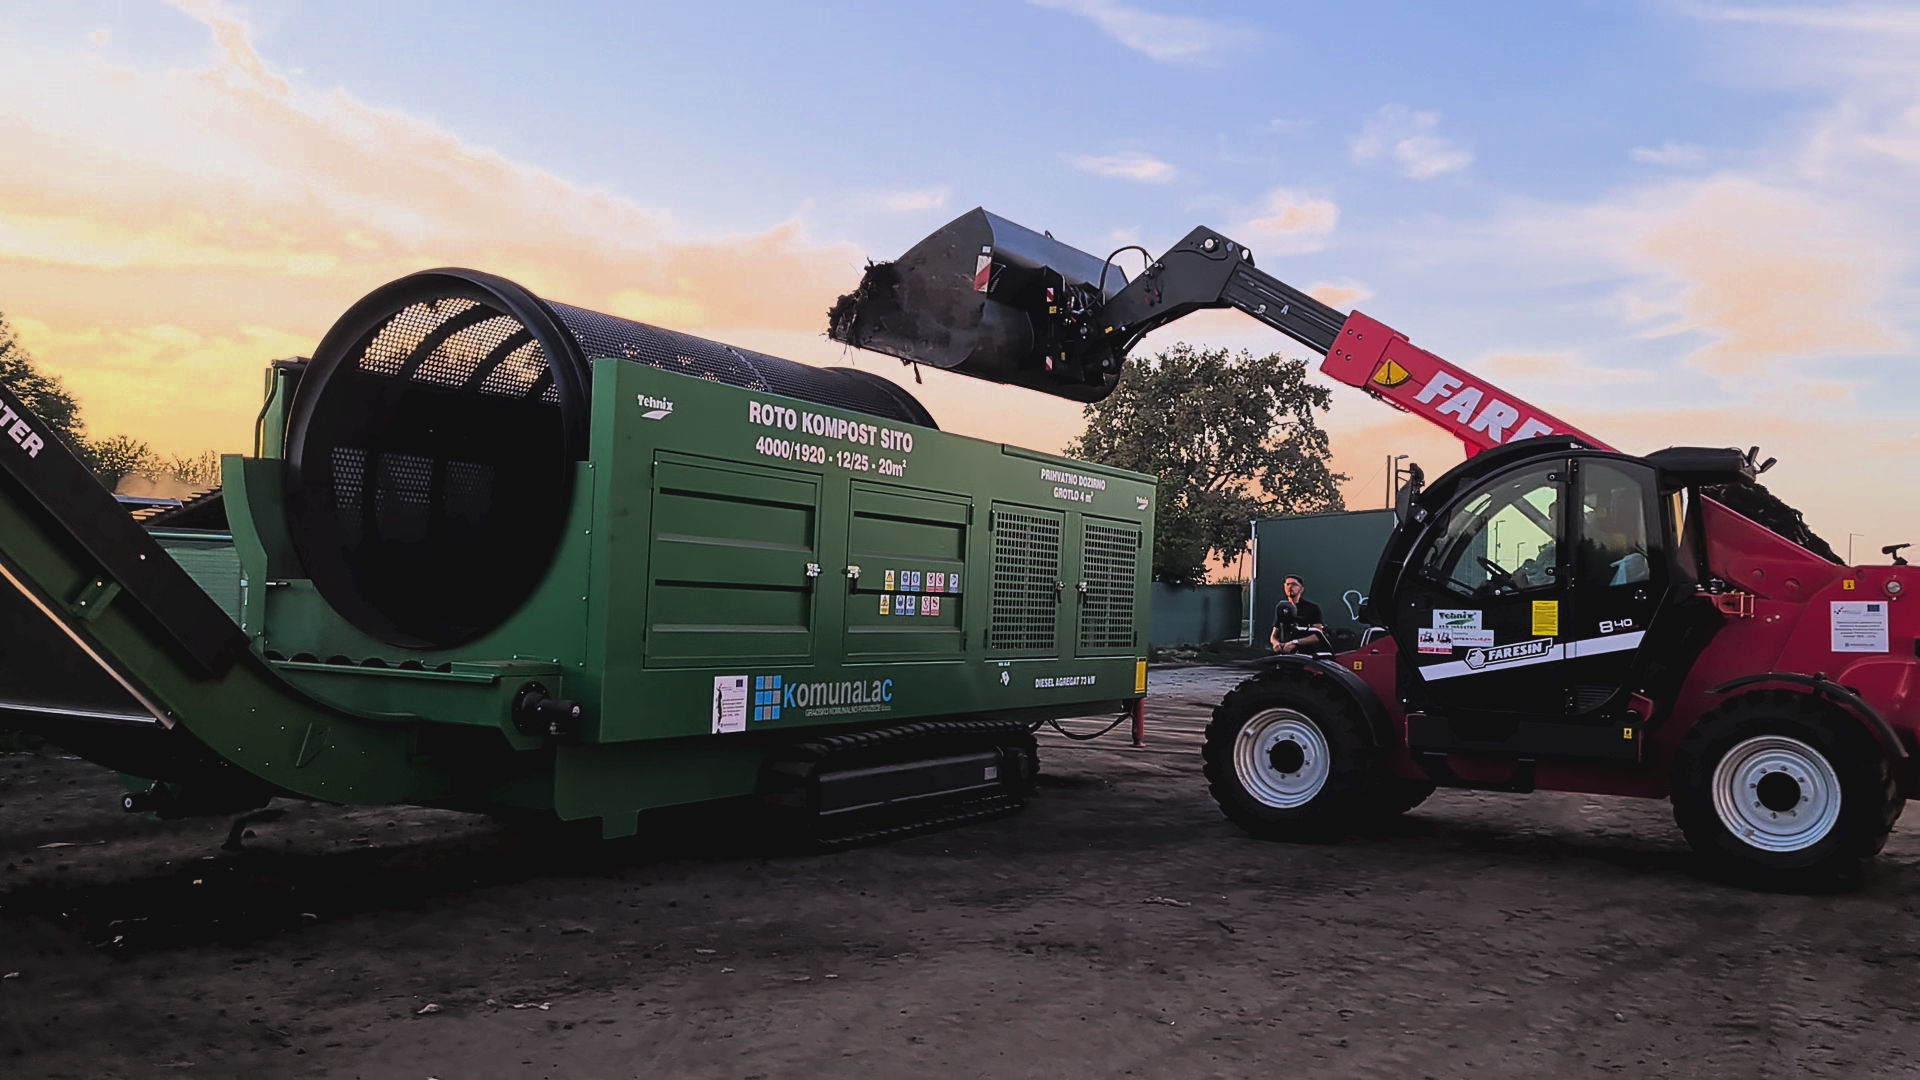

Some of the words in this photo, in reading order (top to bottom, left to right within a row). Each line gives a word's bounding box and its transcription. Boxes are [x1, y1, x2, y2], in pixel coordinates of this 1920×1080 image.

[637, 394, 674, 412] Tehnix
[1413, 370, 1563, 444] FARE
[0, 398, 44, 459] TER
[749, 400, 798, 431] ROTO
[801, 411, 878, 447] KOMPOST
[880, 428, 914, 453] SITO
[755, 435, 826, 465] 4000/1920
[836, 450, 869, 471] 12/25
[1041, 468, 1078, 486] PRIHVATNO
[1078, 475, 1106, 491] DOZIRNO
[1053, 486, 1080, 502] GROTLO
[1080, 491, 1085, 502] 4
[1599, 618, 1633, 634] 840
[1488, 642, 1543, 661] FARESIN
[1035, 677, 1055, 689] DIESEL
[1055, 676, 1080, 688] AGREGAT
